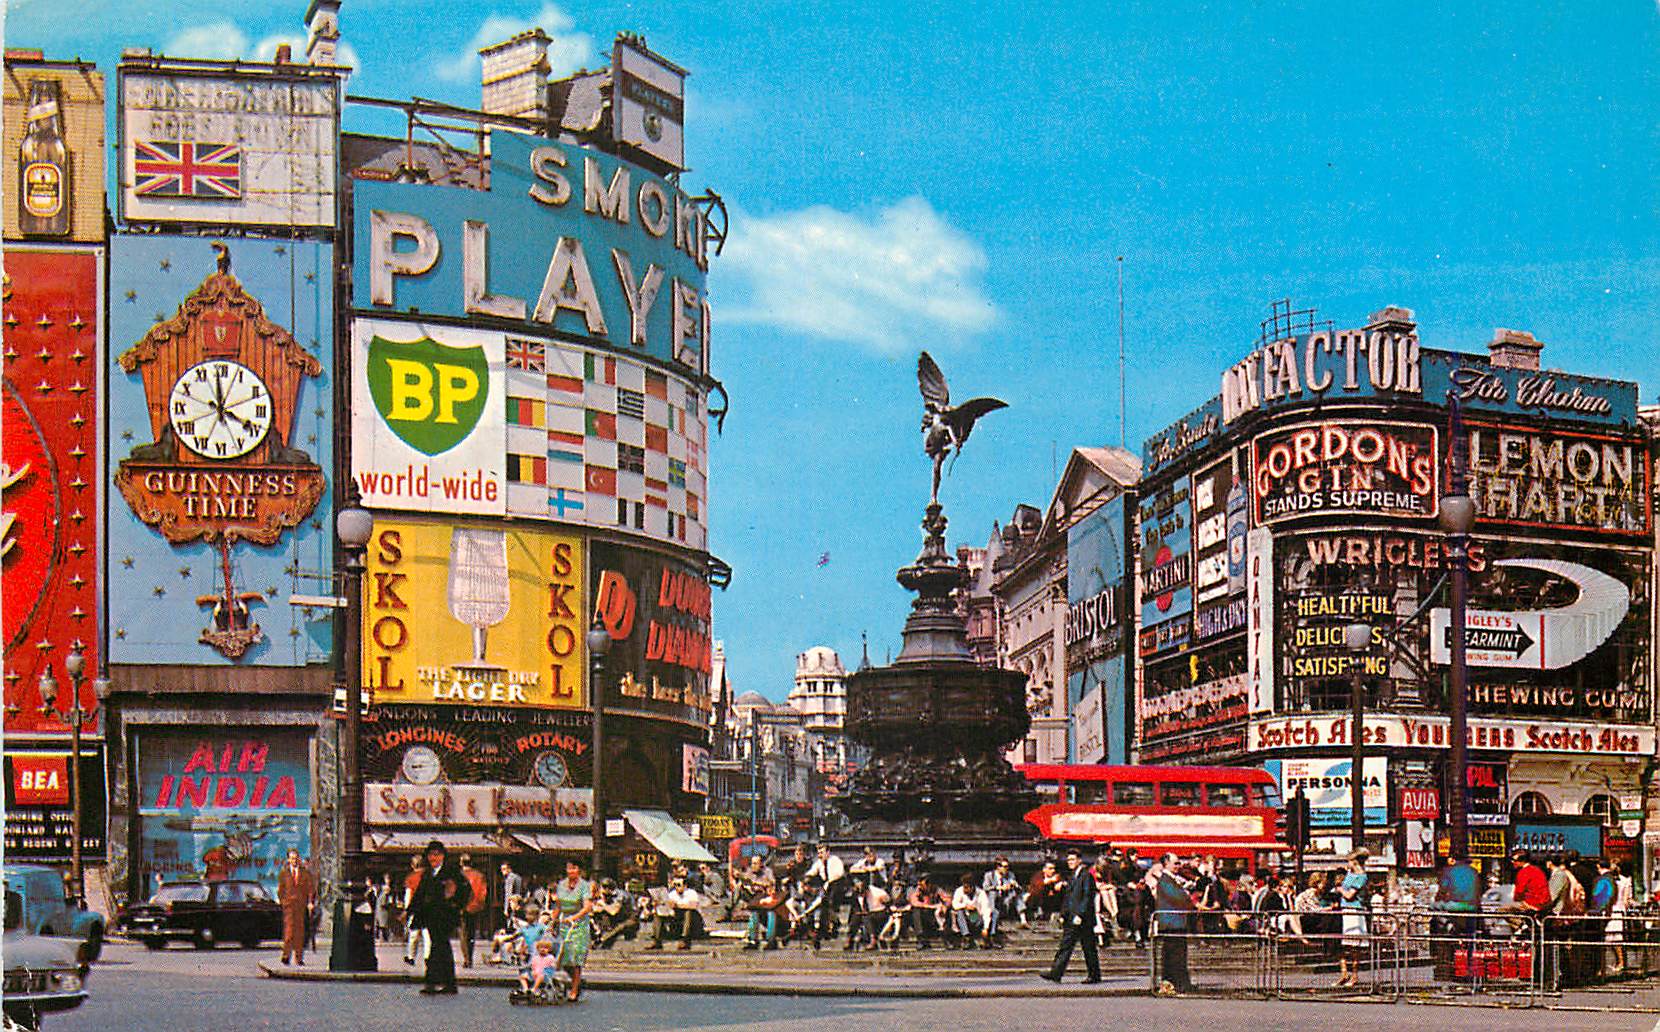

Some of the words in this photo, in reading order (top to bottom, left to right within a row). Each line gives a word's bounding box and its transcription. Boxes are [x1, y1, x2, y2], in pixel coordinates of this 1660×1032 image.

[1264, 330, 1422, 402] FACTOR
[386, 358, 480, 425] BP
[1516, 374, 1612, 413] Charm
[256, 405, 266, 418] III
[1257, 425, 1432, 497] GORDON'S
[1470, 431, 1633, 486] LEMON
[144, 471, 297, 496] GUINNESS
[360, 464, 498, 502] world-wide
[1298, 465, 1375, 493] GIN
[183, 497, 258, 519] TIME
[1264, 492, 1324, 517] STANDS
[1330, 491, 1421, 510] SUPREME
[1487, 476, 1610, 528] HART
[1141, 555, 1187, 596] MARTINI
[372, 529, 409, 693] SKOL
[547, 543, 576, 699] SKOL
[1064, 587, 1117, 647] BRISTOL
[1467, 615, 1512, 628] IGLEY'S
[1253, 555, 1261, 708] QANTAS
[433, 681, 527, 703] LAGER
[508, 671, 539, 685] DRY
[1586, 688, 1638, 709] GUM
[455, 708, 518, 724] LEADING
[377, 726, 467, 753] LONGINES
[516, 731, 588, 756] ROTARY
[1257, 720, 1320, 748] Scotch
[1525, 724, 1593, 752] Scotch
[1596, 728, 1640, 752] Ales
[183, 740, 269, 774] AIR
[21, 769, 60, 790] BEA
[154, 774, 298, 809] INDIA
[1403, 792, 1437, 811] AVIA
[1407, 851, 1435, 868] AVIA
